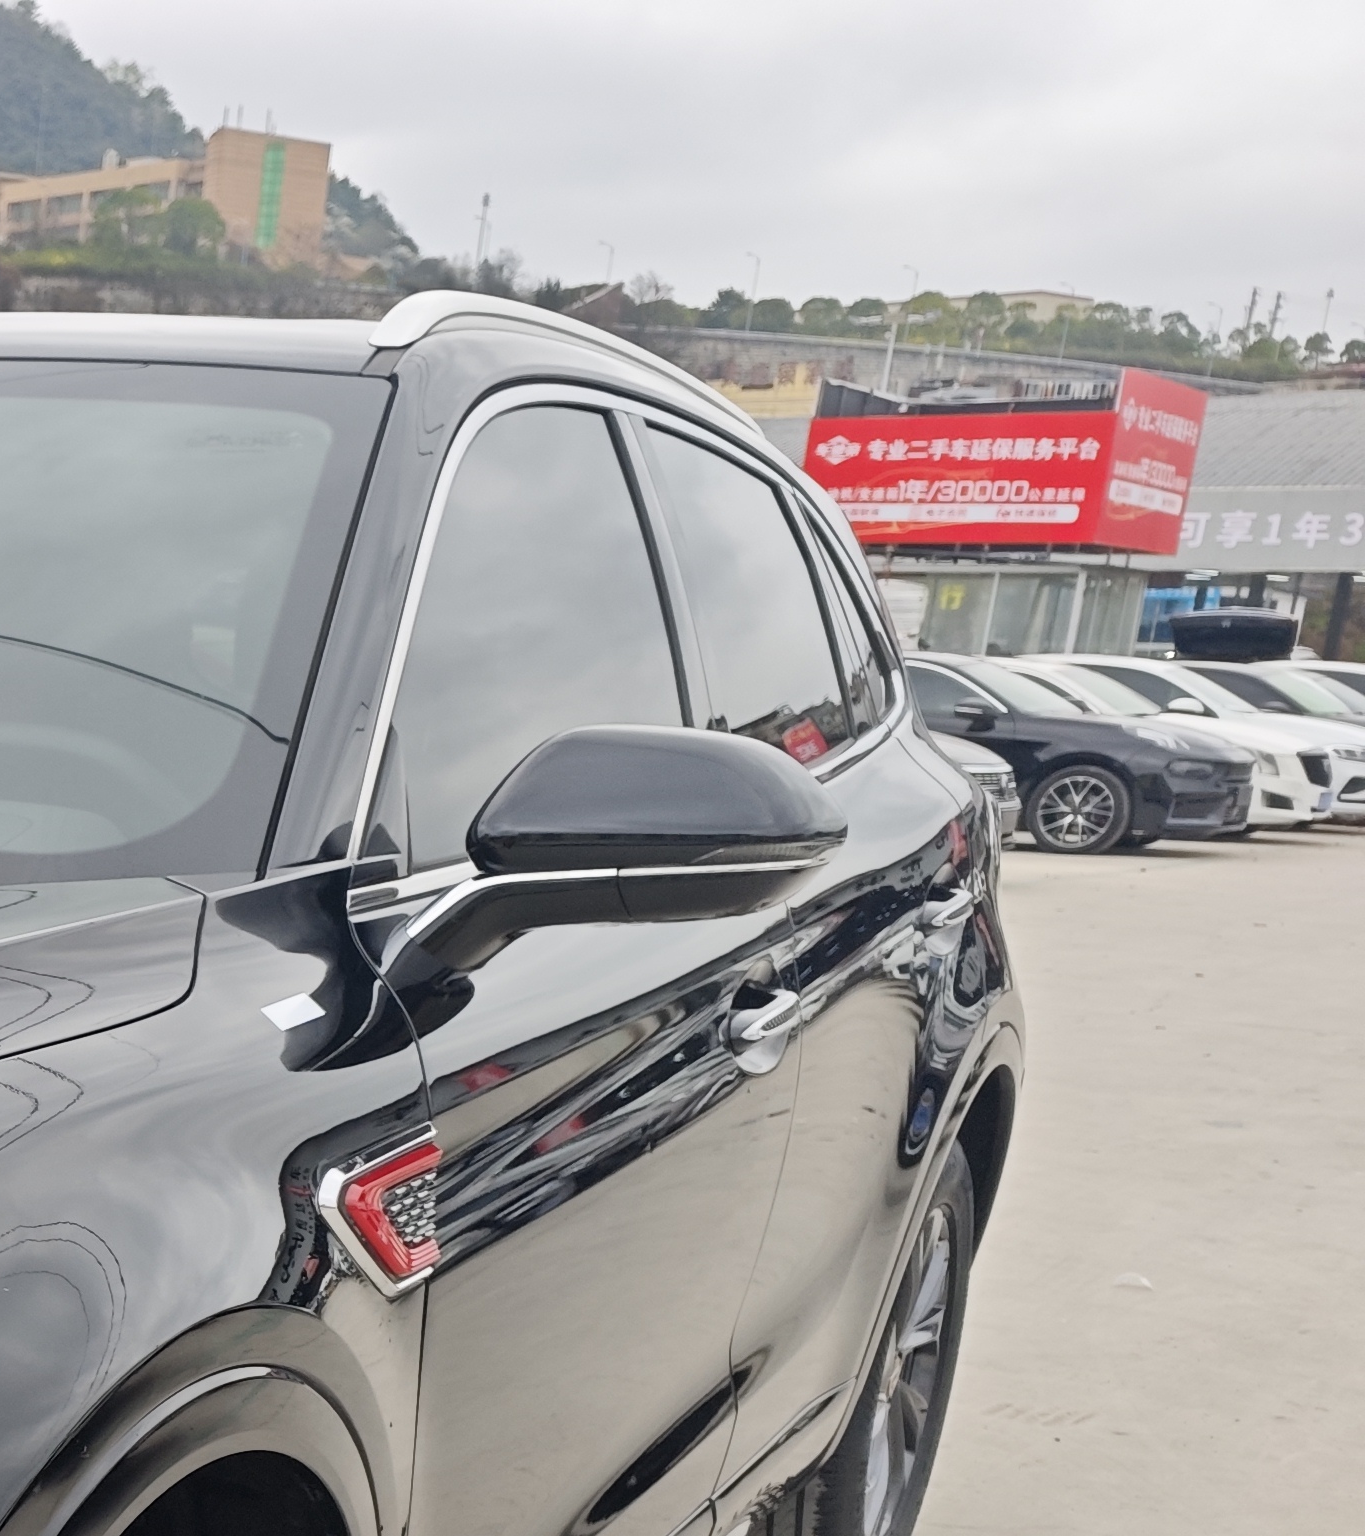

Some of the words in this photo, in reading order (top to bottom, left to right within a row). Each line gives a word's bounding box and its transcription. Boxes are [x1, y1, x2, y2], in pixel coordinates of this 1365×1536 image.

[866, 436, 1102, 463] 专业二手车延保服务平台
